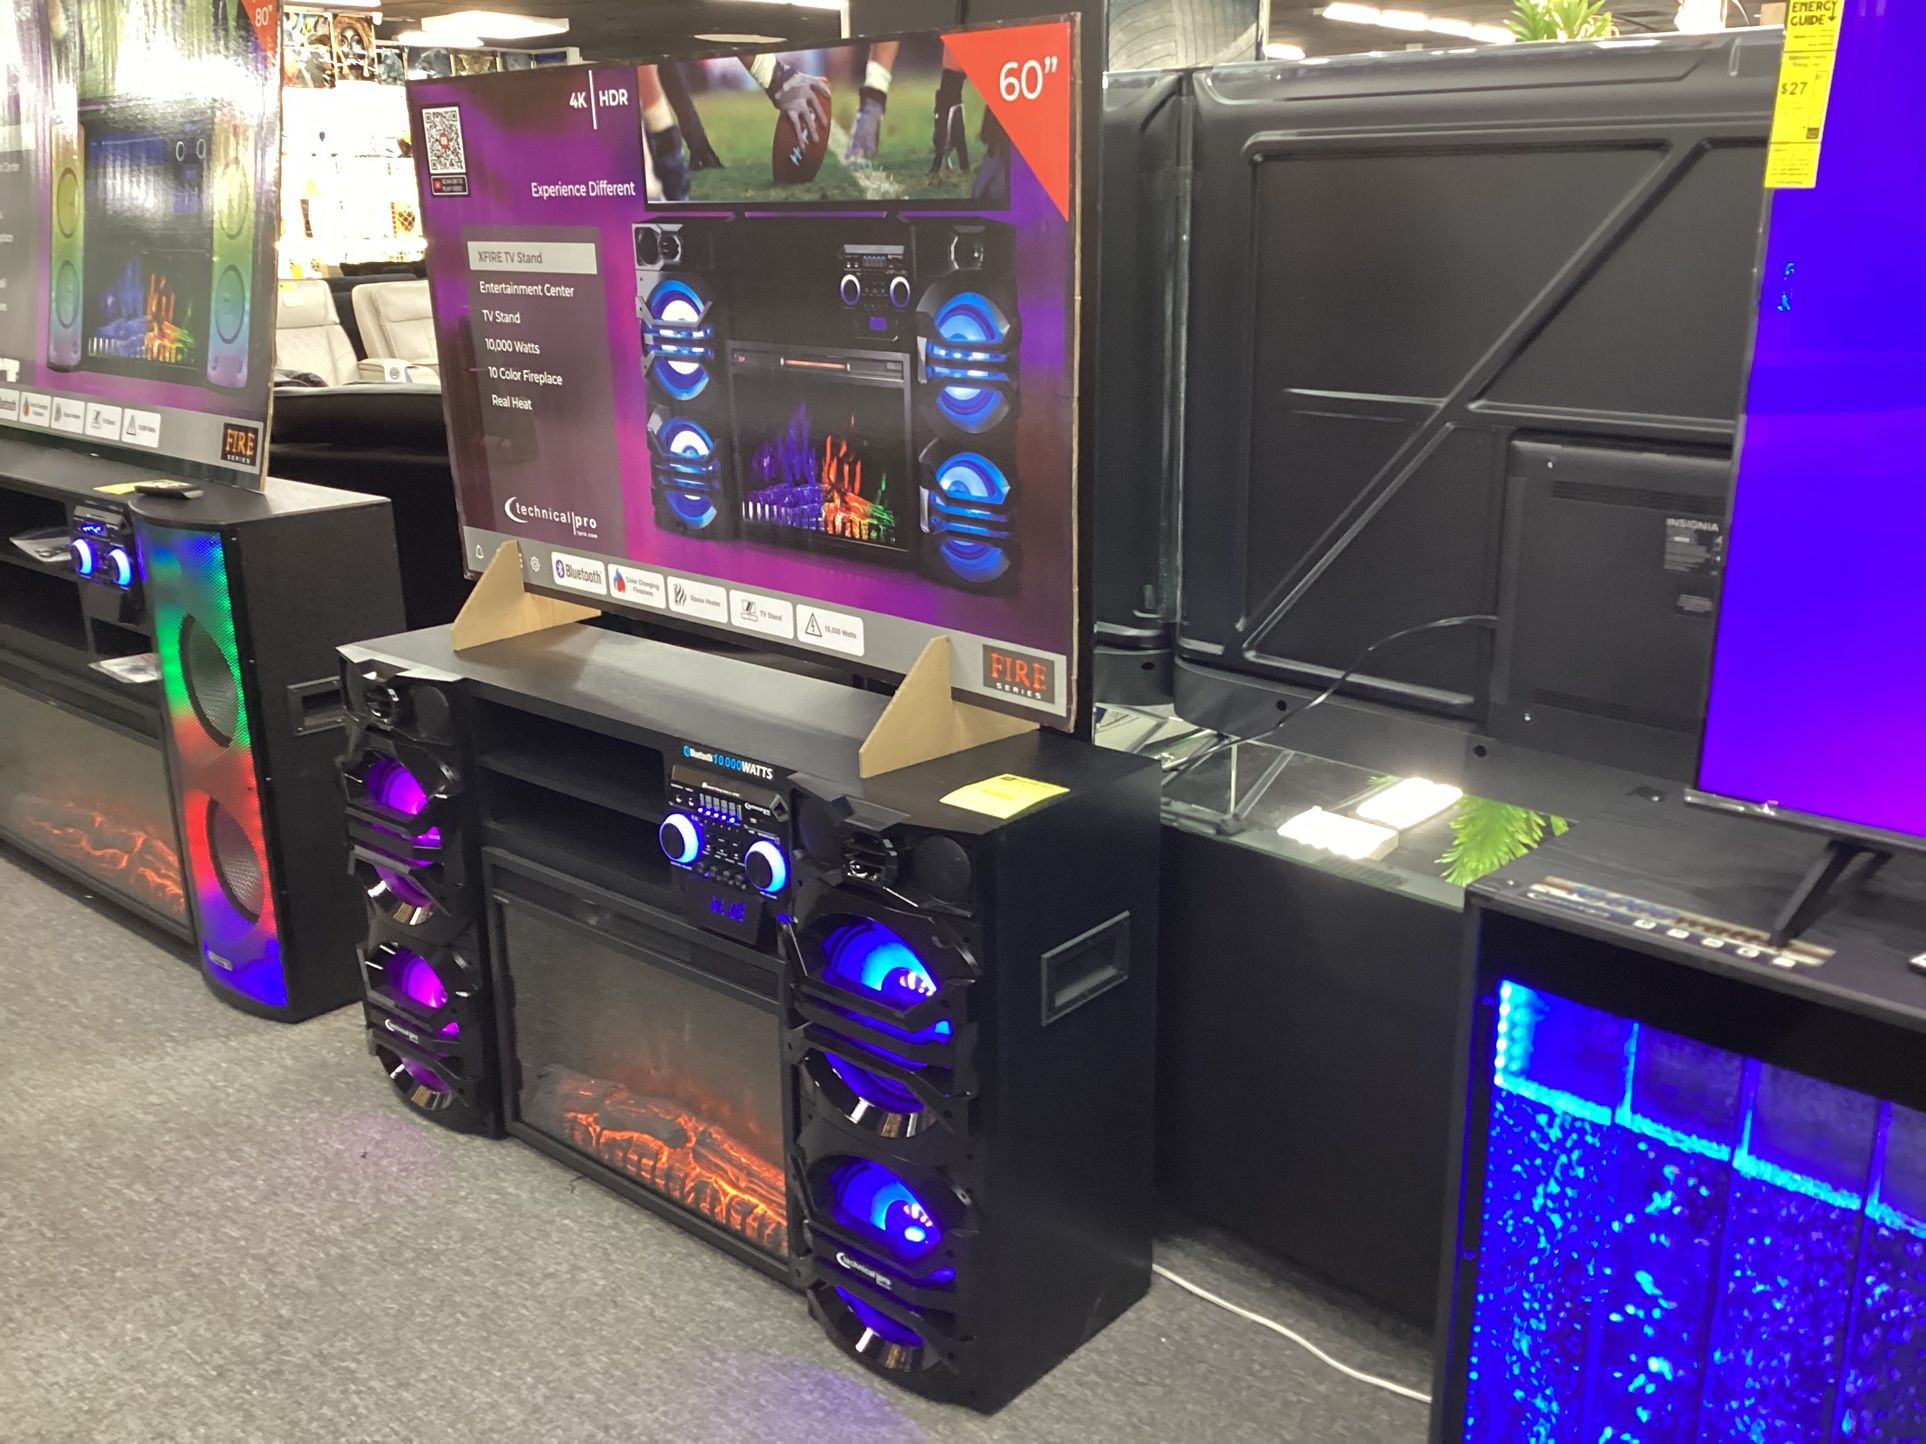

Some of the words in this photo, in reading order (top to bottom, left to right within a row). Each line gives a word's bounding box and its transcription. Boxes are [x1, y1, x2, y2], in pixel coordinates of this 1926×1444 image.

[1792, 0, 1838, 12] ENERGY
[1790, 14, 1826, 26] GUIDE
[1781, 81, 1808, 96] $27
[569, 91, 587, 109] 4K
[599, 89, 628, 107] HDR
[531, 182, 587, 199] Experience
[588, 180, 636, 197] Different
[478, 250, 502, 263] XFIRE
[504, 251, 514, 263] TV
[517, 252, 543, 264] Stand
[479, 281, 543, 296] Entertainment
[544, 284, 574, 297] Center
[482, 310, 494, 322] TV
[495, 310, 521, 324] Stand
[485, 338, 513, 352] 10,000
[514, 341, 540, 355] Watts
[488, 366, 497, 379] 10
[499, 368, 522, 381] Color
[523, 370, 563, 386] Fireplace
[491, 394, 511, 408] Real
[512, 397, 533, 410] Heat
[226, 429, 255, 455] FIRE
[575, 515, 597, 529] pro
[565, 563, 602, 585] Bluetooth
[991, 652, 1047, 691] FIRE
[996, 682, 1042, 699] SERIES
